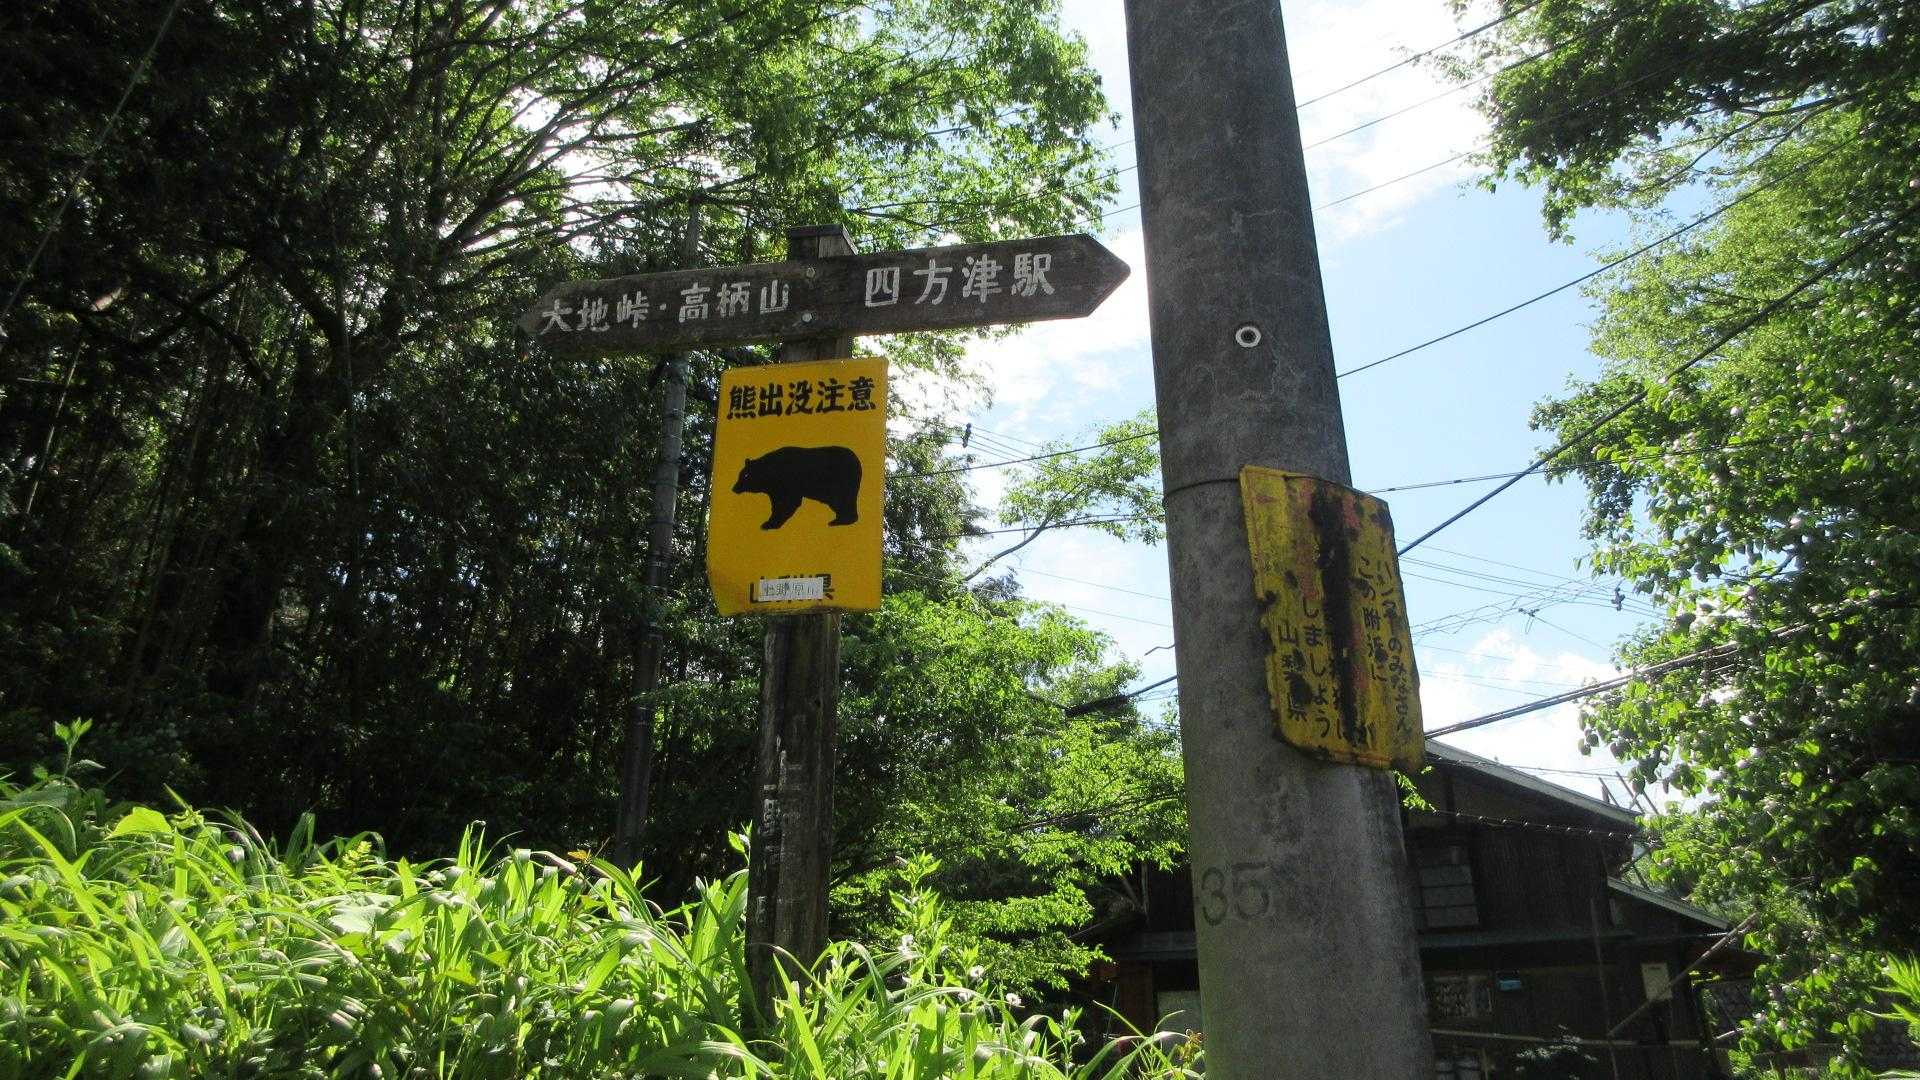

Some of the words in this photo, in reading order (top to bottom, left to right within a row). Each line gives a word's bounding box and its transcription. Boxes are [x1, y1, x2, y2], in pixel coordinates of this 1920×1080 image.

[865, 253, 1055, 307] 四方津駅
[727, 376, 876, 420] 熊出没注意
[1201, 862, 1269, 926] 35
